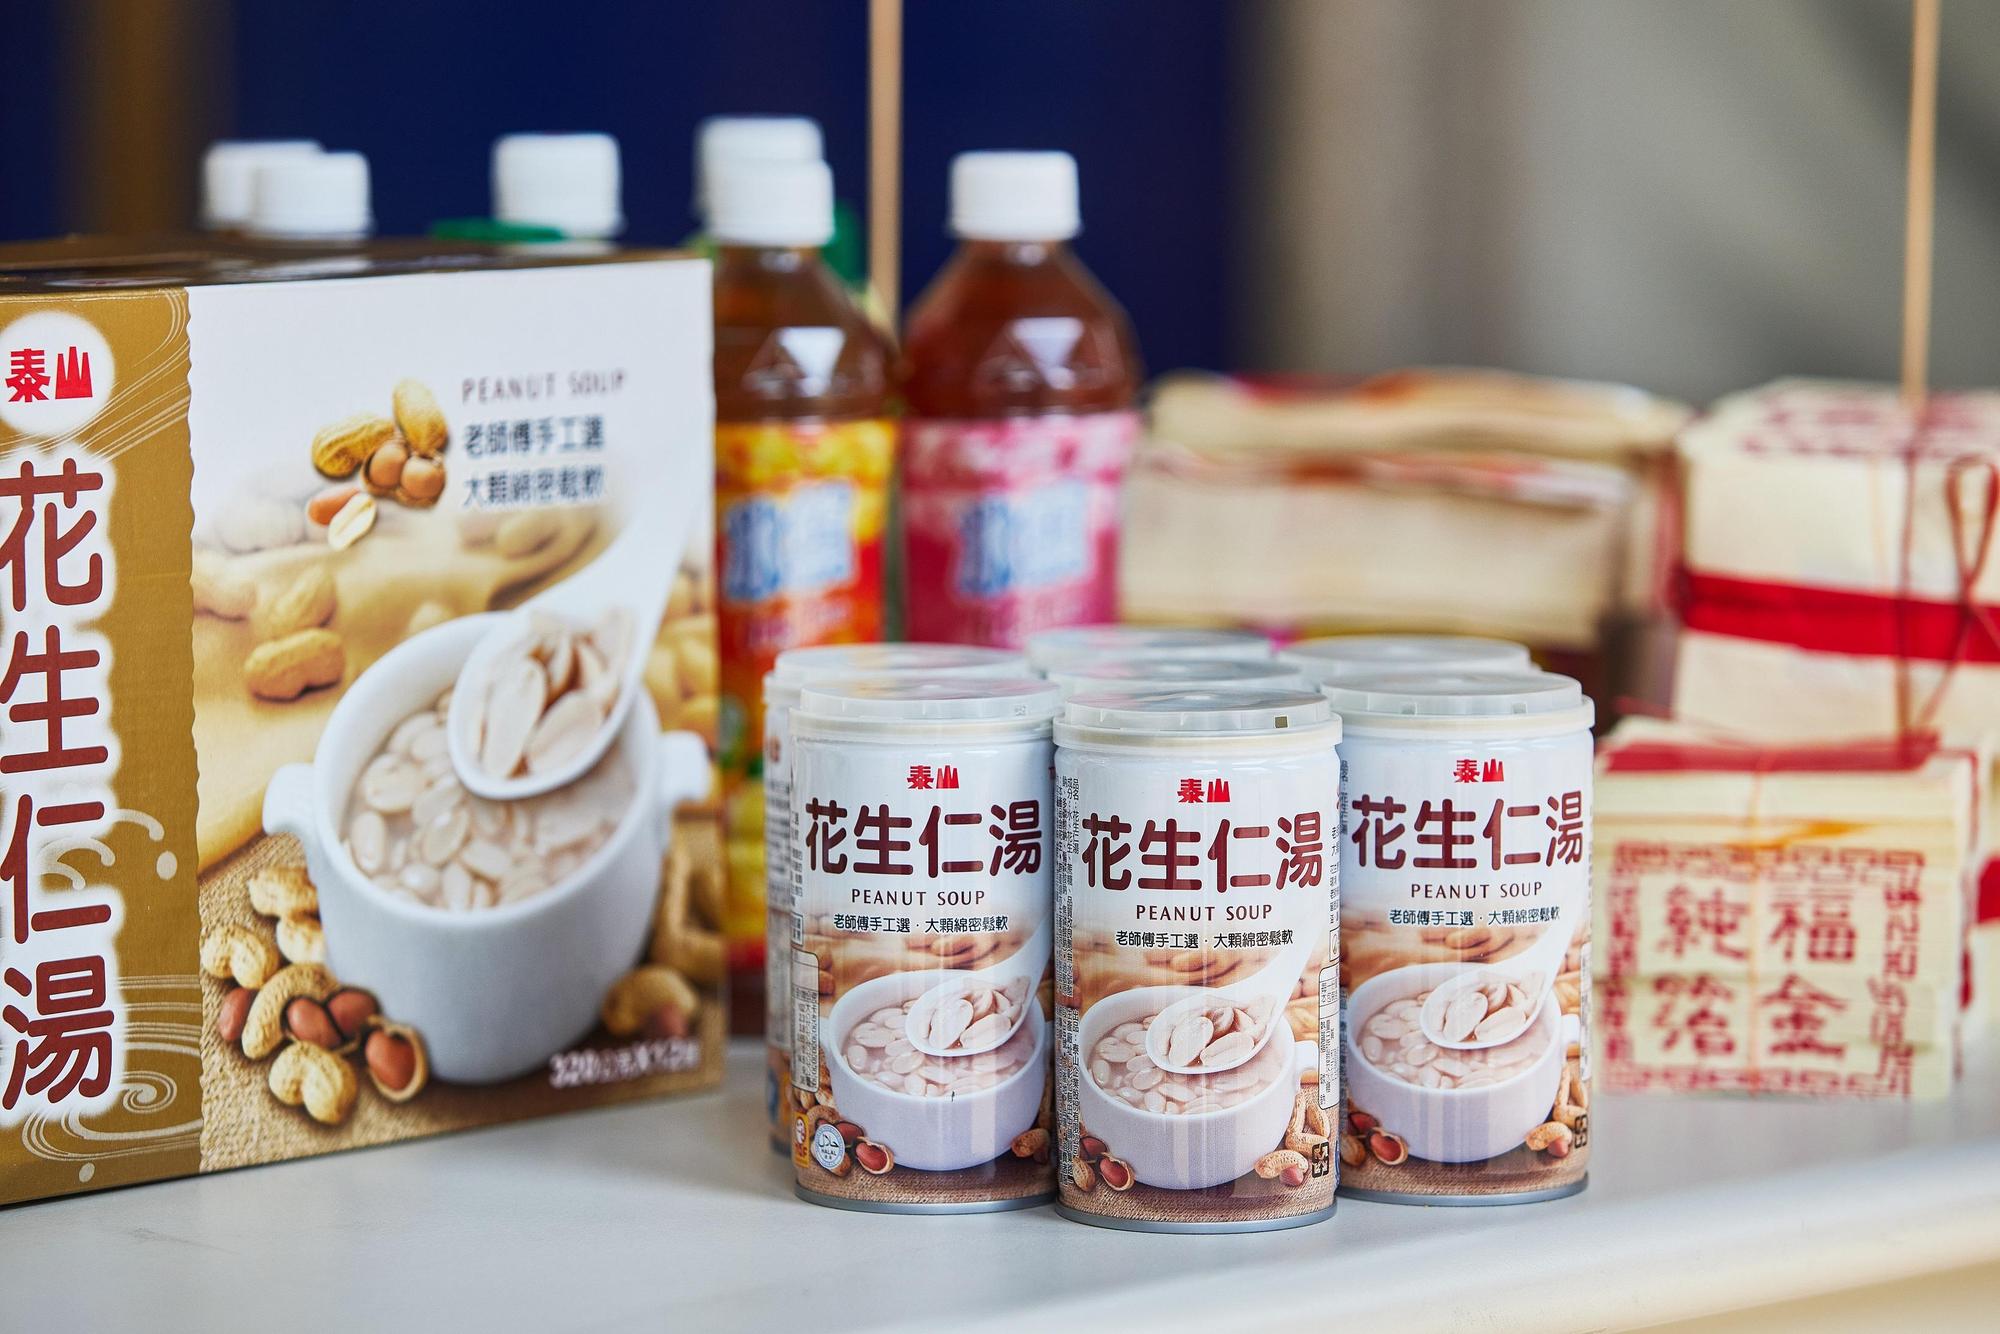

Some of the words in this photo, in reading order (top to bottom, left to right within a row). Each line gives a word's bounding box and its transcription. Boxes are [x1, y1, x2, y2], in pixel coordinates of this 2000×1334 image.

[6, 346, 94, 403] 泰山
[462, 374, 556, 405] PEANUT
[569, 368, 628, 398] SOUP
[0, 458, 114, 1110] 花生仁湯
[906, 765, 960, 790] 泰山
[1453, 758, 1505, 784] 泰山
[1177, 778, 1231, 804] 泰山
[805, 797, 1042, 878] 花生仁湯
[1351, 790, 1583, 871] 花生仁湯
[1081, 811, 1323, 893] 花生仁湯
[851, 888, 927, 906] PEANUT
[938, 890, 986, 906] SOUP
[1411, 883, 1491, 899] PEANUT
[1500, 882, 1543, 898] SOUP
[1136, 904, 1216, 922] PEANUT
[1226, 904, 1273, 921] SOUP
